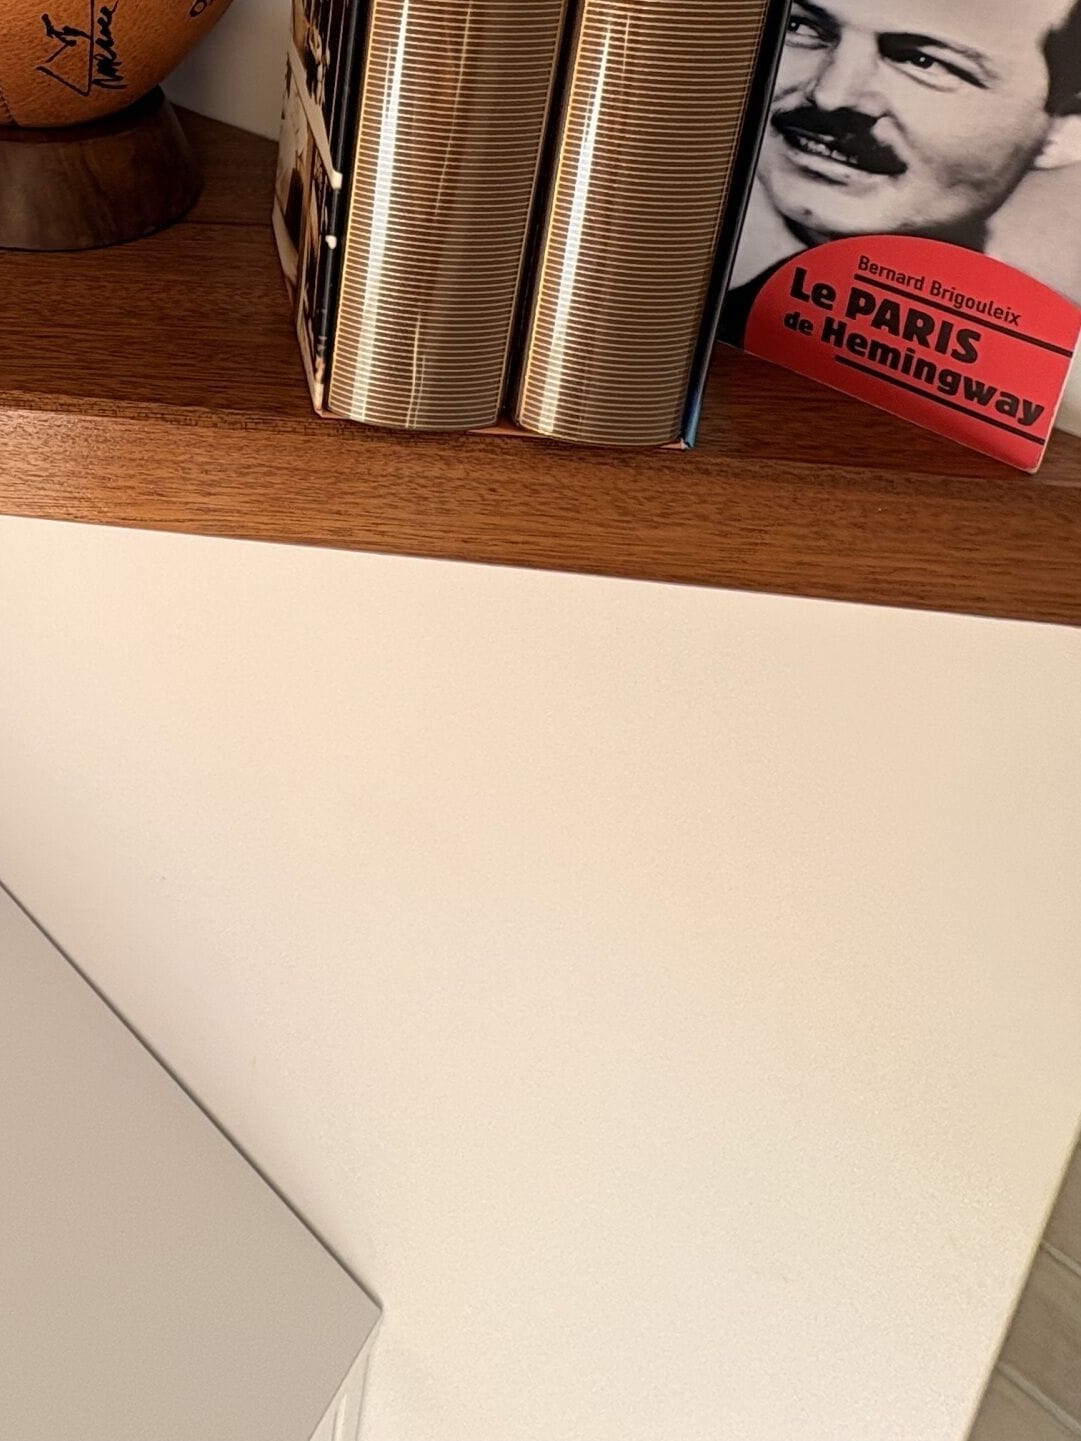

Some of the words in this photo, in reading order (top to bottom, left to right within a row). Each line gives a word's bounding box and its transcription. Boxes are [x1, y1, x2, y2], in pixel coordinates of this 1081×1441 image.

[789, 267, 837, 310] Le
[846, 286, 983, 365] PARIS
[857, 254, 925, 292] Bernard
[929, 279, 1022, 327] Brigouleix
[783, 311, 814, 337] de
[820, 316, 1046, 427] Hemingway
